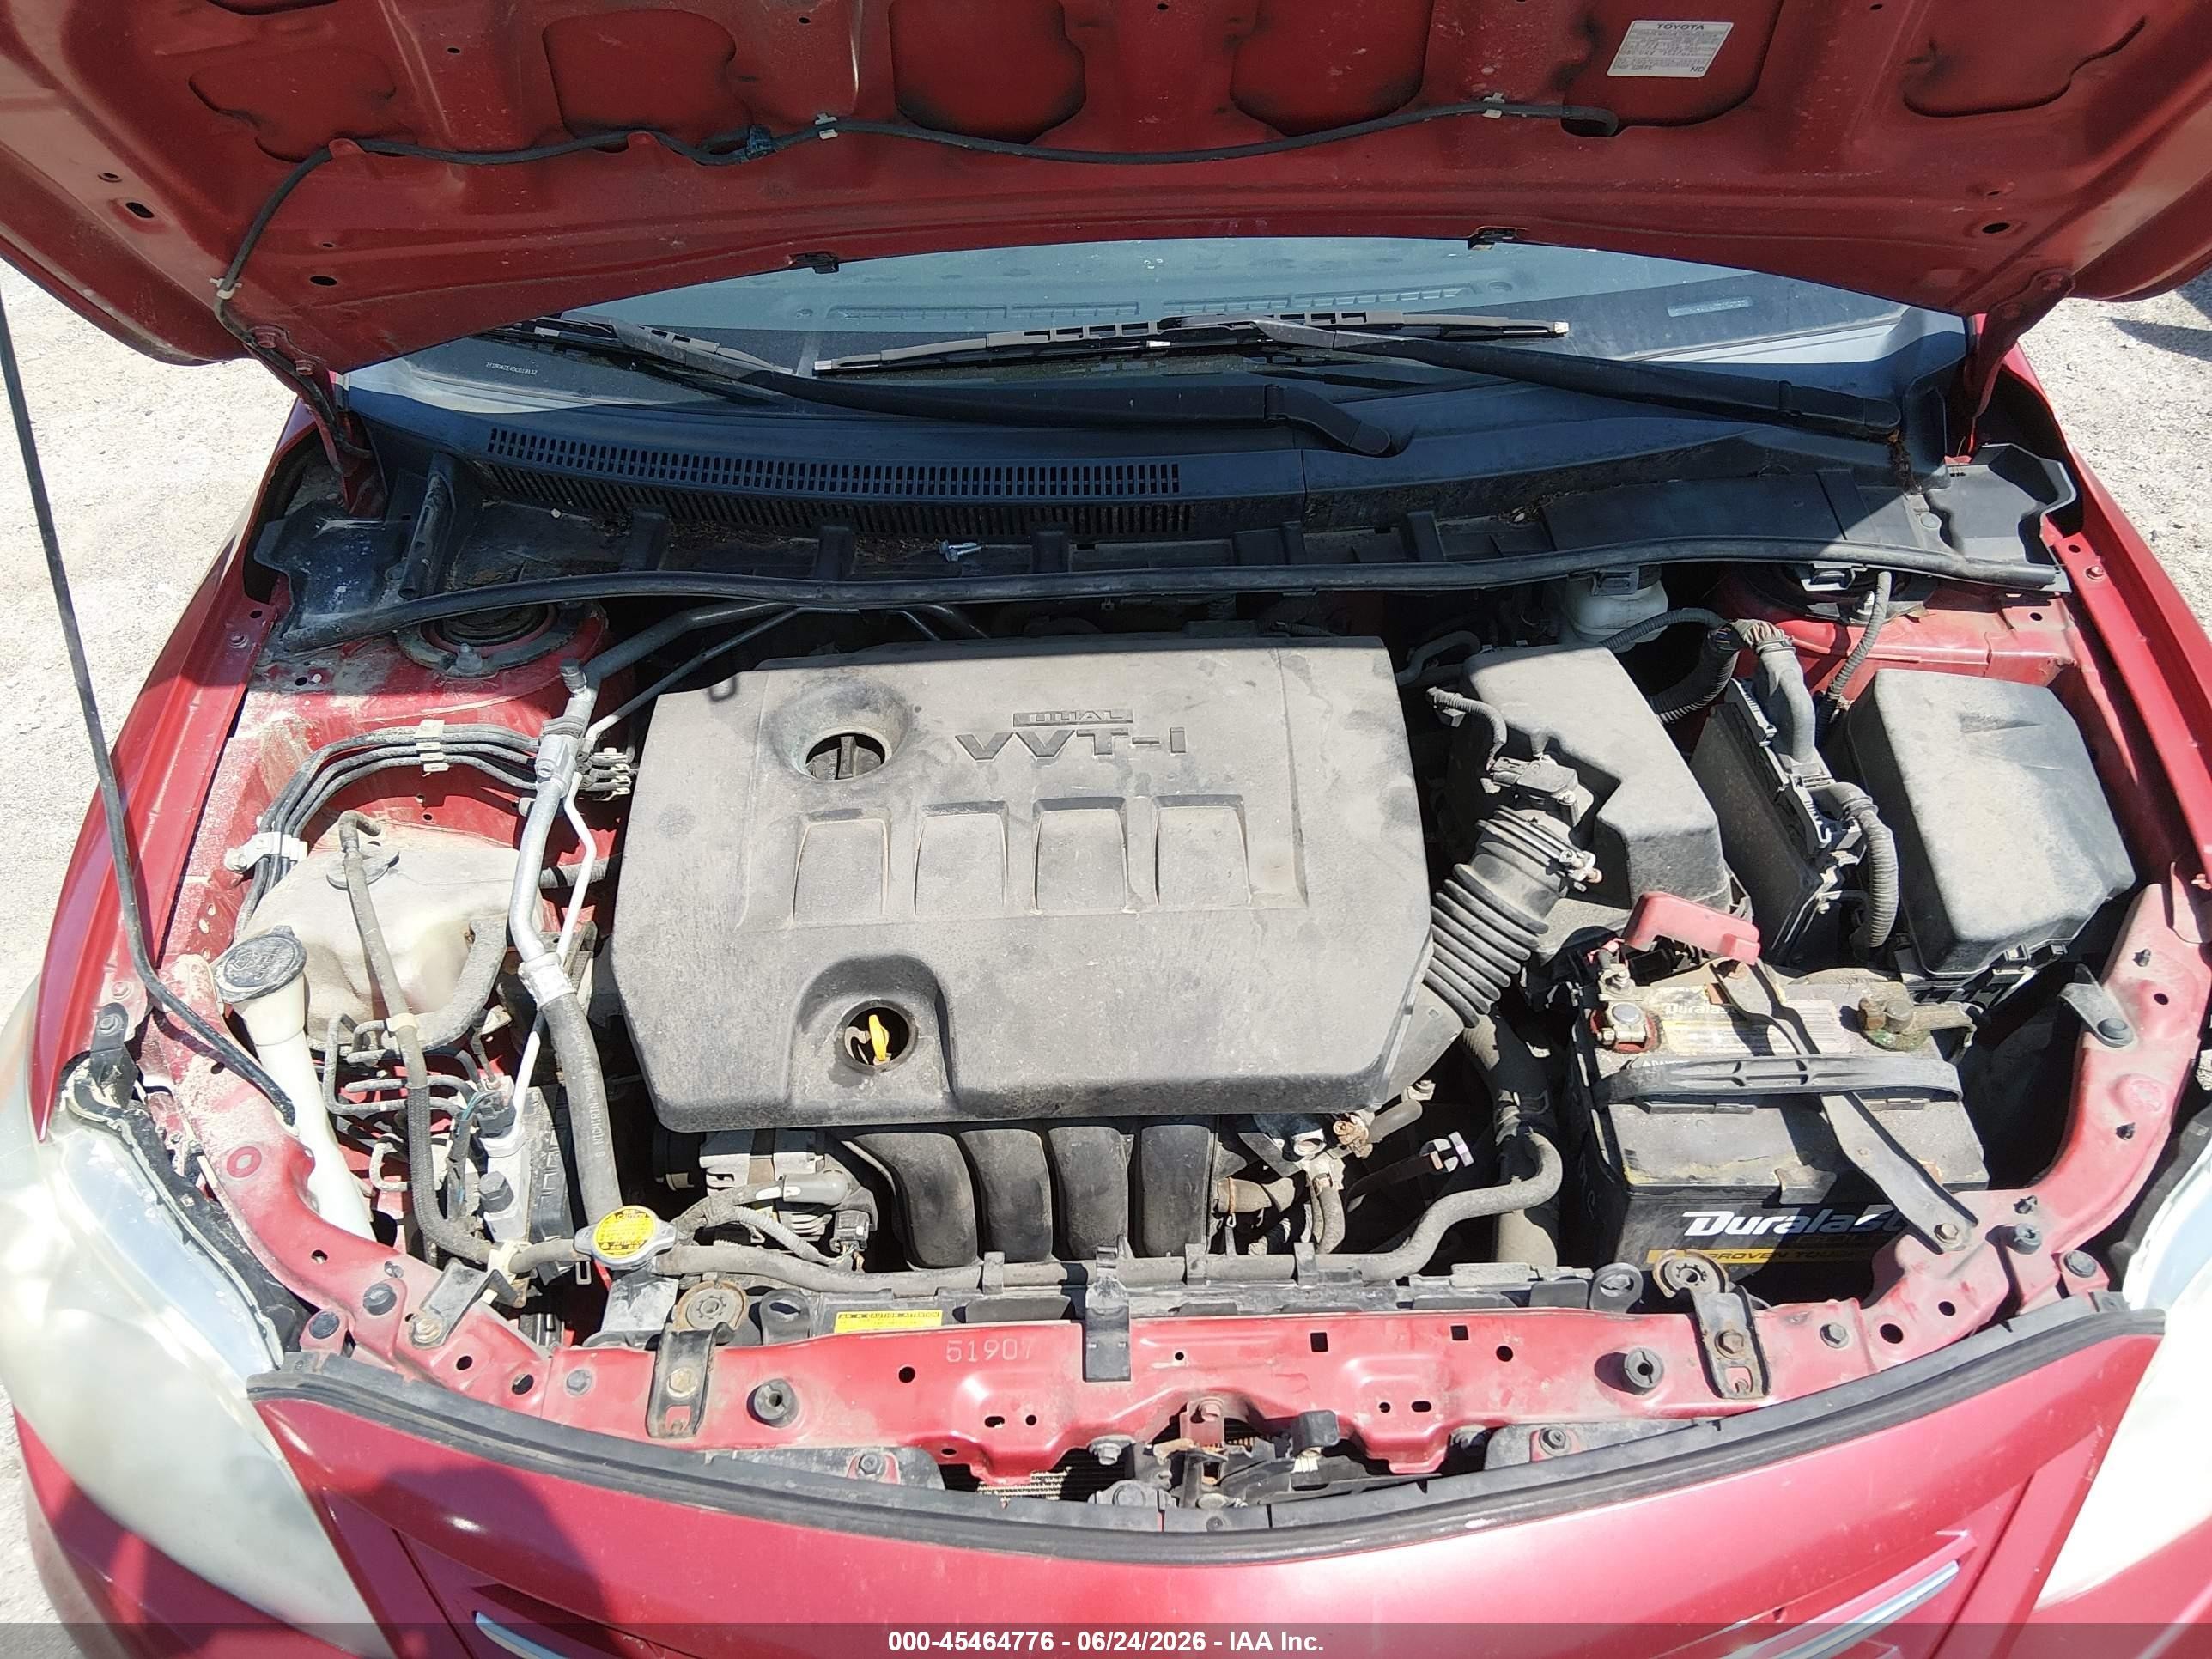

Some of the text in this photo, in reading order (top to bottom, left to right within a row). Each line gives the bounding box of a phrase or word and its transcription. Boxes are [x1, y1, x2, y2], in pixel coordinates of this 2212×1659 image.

[1029, 710, 1126, 724] DUAL
[589, 1102, 605, 1146] NICHIRIN
[1682, 1206, 1904, 1237] Duralast
[946, 1339, 1031, 1362] 51907
